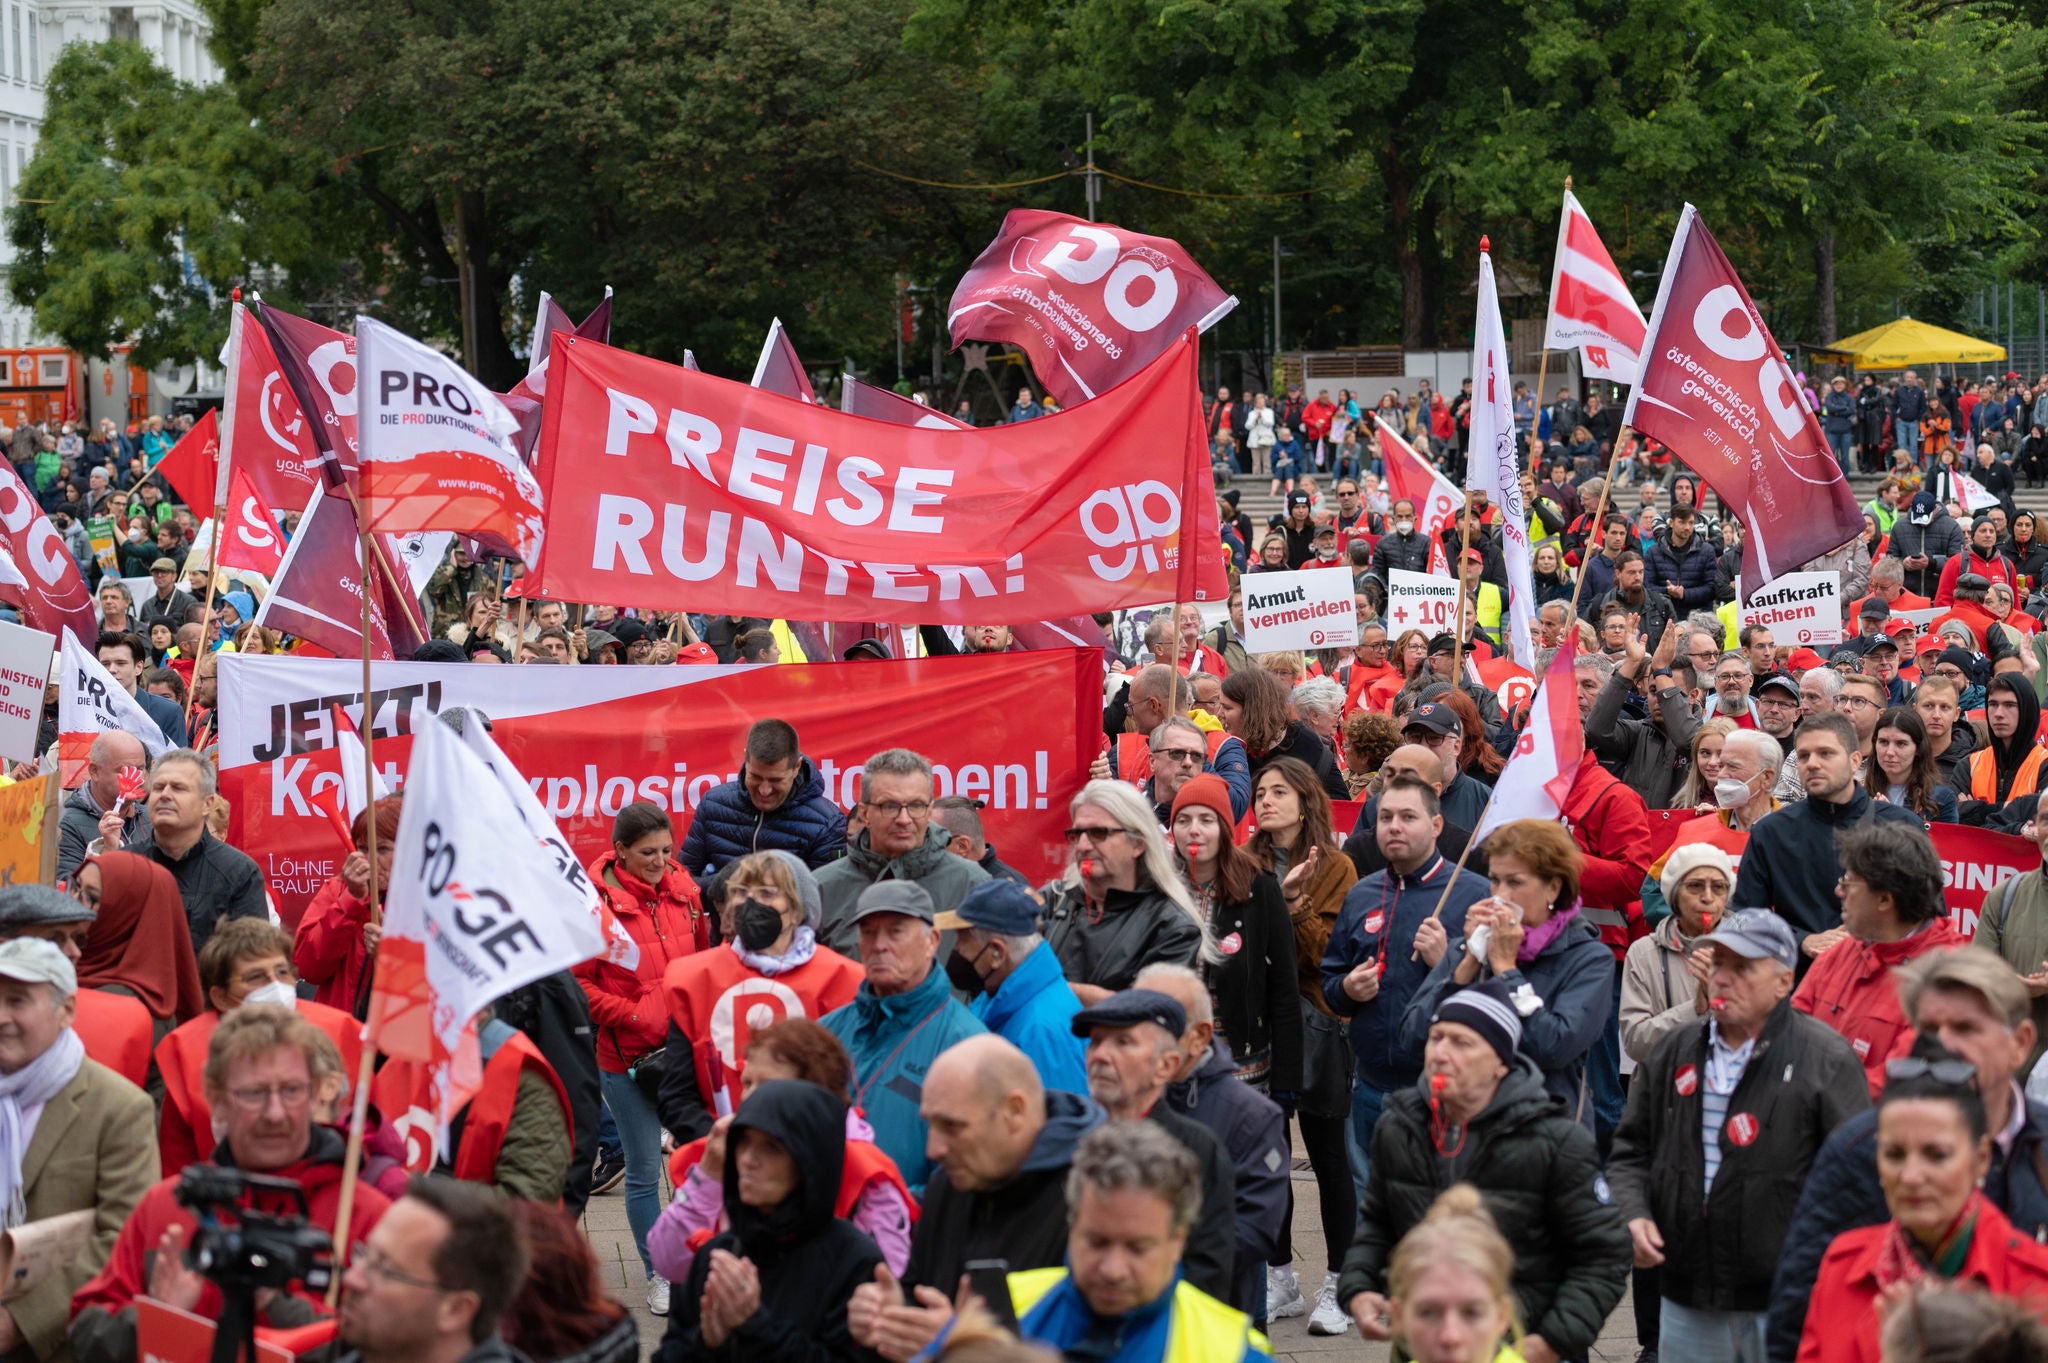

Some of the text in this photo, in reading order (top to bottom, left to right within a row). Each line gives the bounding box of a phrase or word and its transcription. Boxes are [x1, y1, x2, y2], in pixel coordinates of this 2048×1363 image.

[1666, 347, 1761, 430] österreichische
[380, 414, 399, 425] DIE
[1703, 428, 1742, 466] SEIT 1945
[605, 387, 955, 534] PREISE
[592, 493, 1025, 603] RUNTER!
[1247, 585, 1306, 611] Armut
[1391, 583, 1456, 597] Pensionen:
[1250, 599, 1351, 630] vermeiden
[1744, 603, 1816, 628] sichern
[0, 667, 43, 691] NISTEN
[77, 696, 91, 706] DIE
[252, 680, 442, 763] JETZT!
[268, 852, 335, 877] LÖHNE
